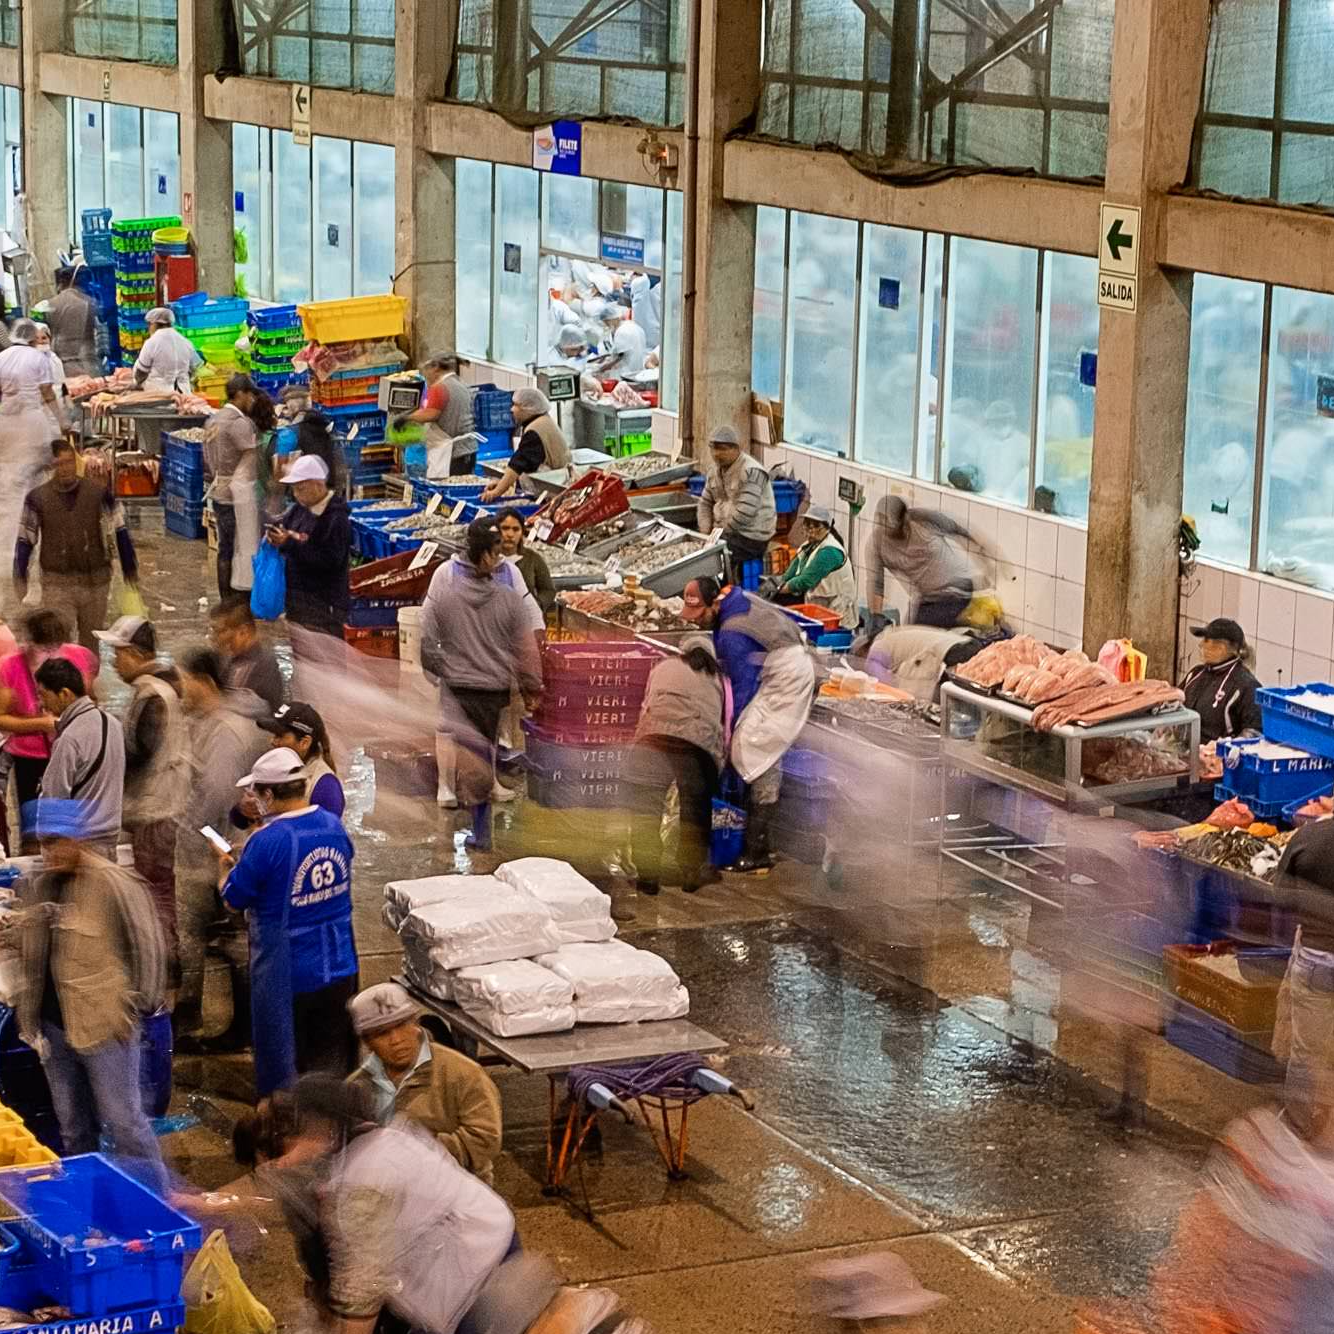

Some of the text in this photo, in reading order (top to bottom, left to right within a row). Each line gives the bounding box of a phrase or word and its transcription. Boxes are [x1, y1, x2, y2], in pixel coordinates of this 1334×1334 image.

[558, 138, 578, 151] FILETE
[1100, 281, 1133, 301] SALIDA
[589, 674, 629, 687] VIERI
[587, 695, 627, 707] VIERI
[586, 712, 627, 724] VIERI
[582, 750, 623, 762] VIERI
[311, 860, 336, 890] 63
[85, 1234, 185, 1267] S A
[149, 1309, 163, 1329] A
